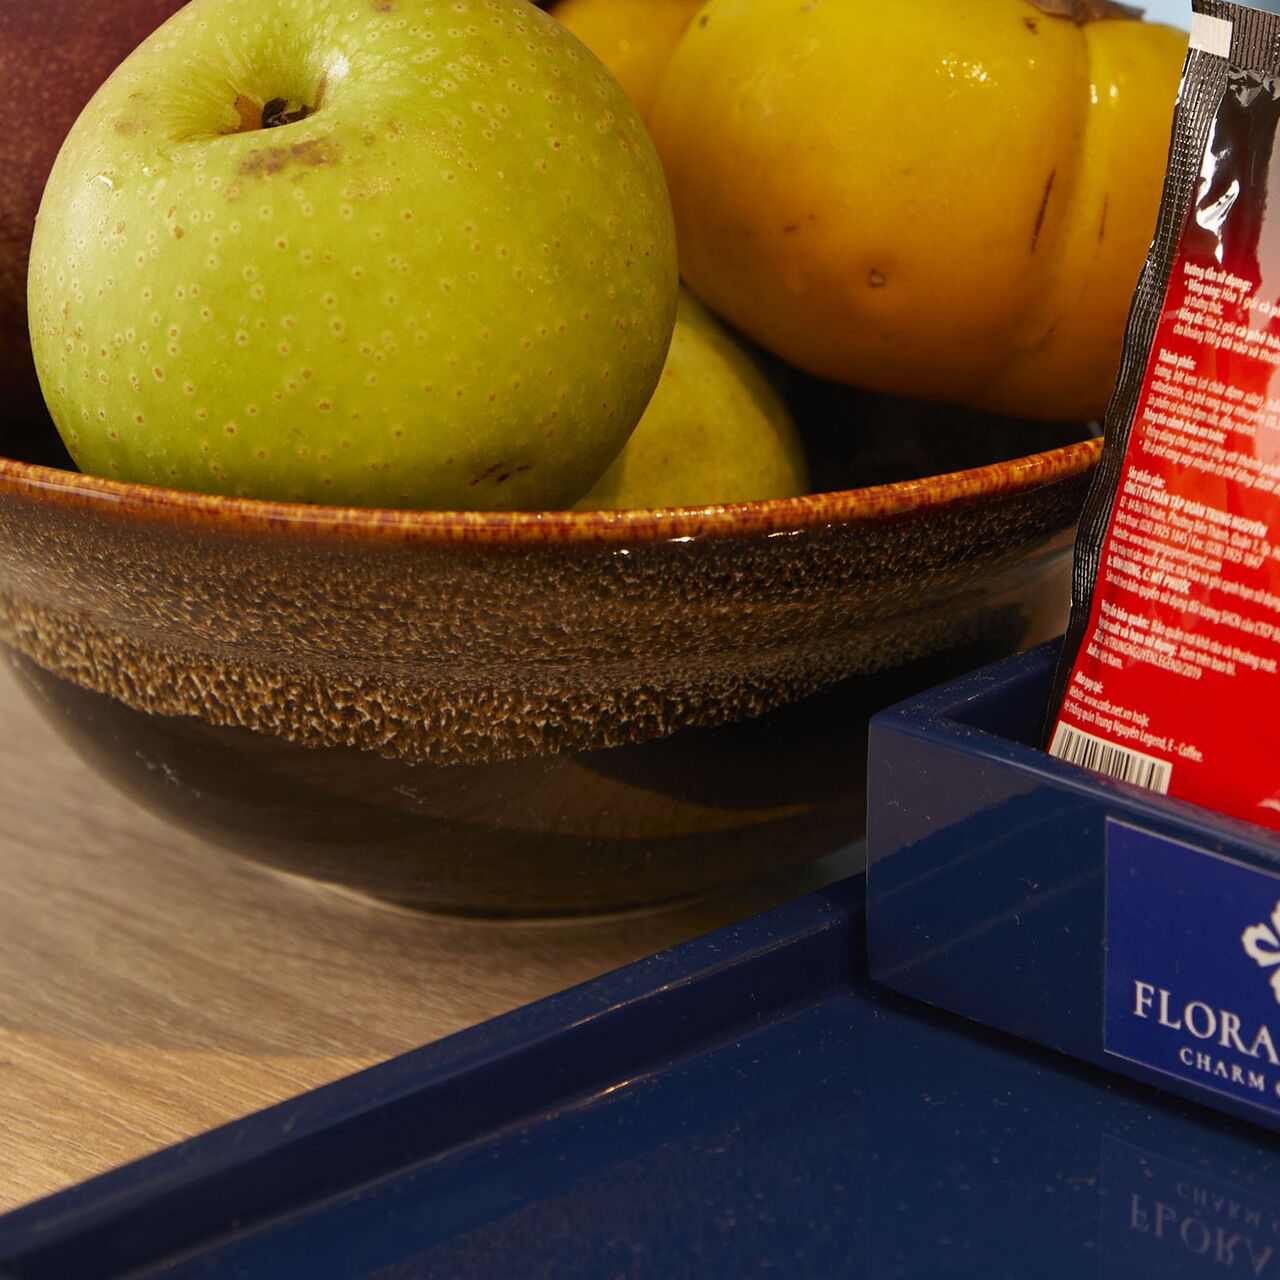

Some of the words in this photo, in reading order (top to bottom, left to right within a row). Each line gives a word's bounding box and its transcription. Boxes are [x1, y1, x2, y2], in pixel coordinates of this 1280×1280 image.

[1215, 318, 1223, 330] 2
[1133, 979, 1280, 1066] FLORA
[1179, 1047, 1265, 1092] CHARM
